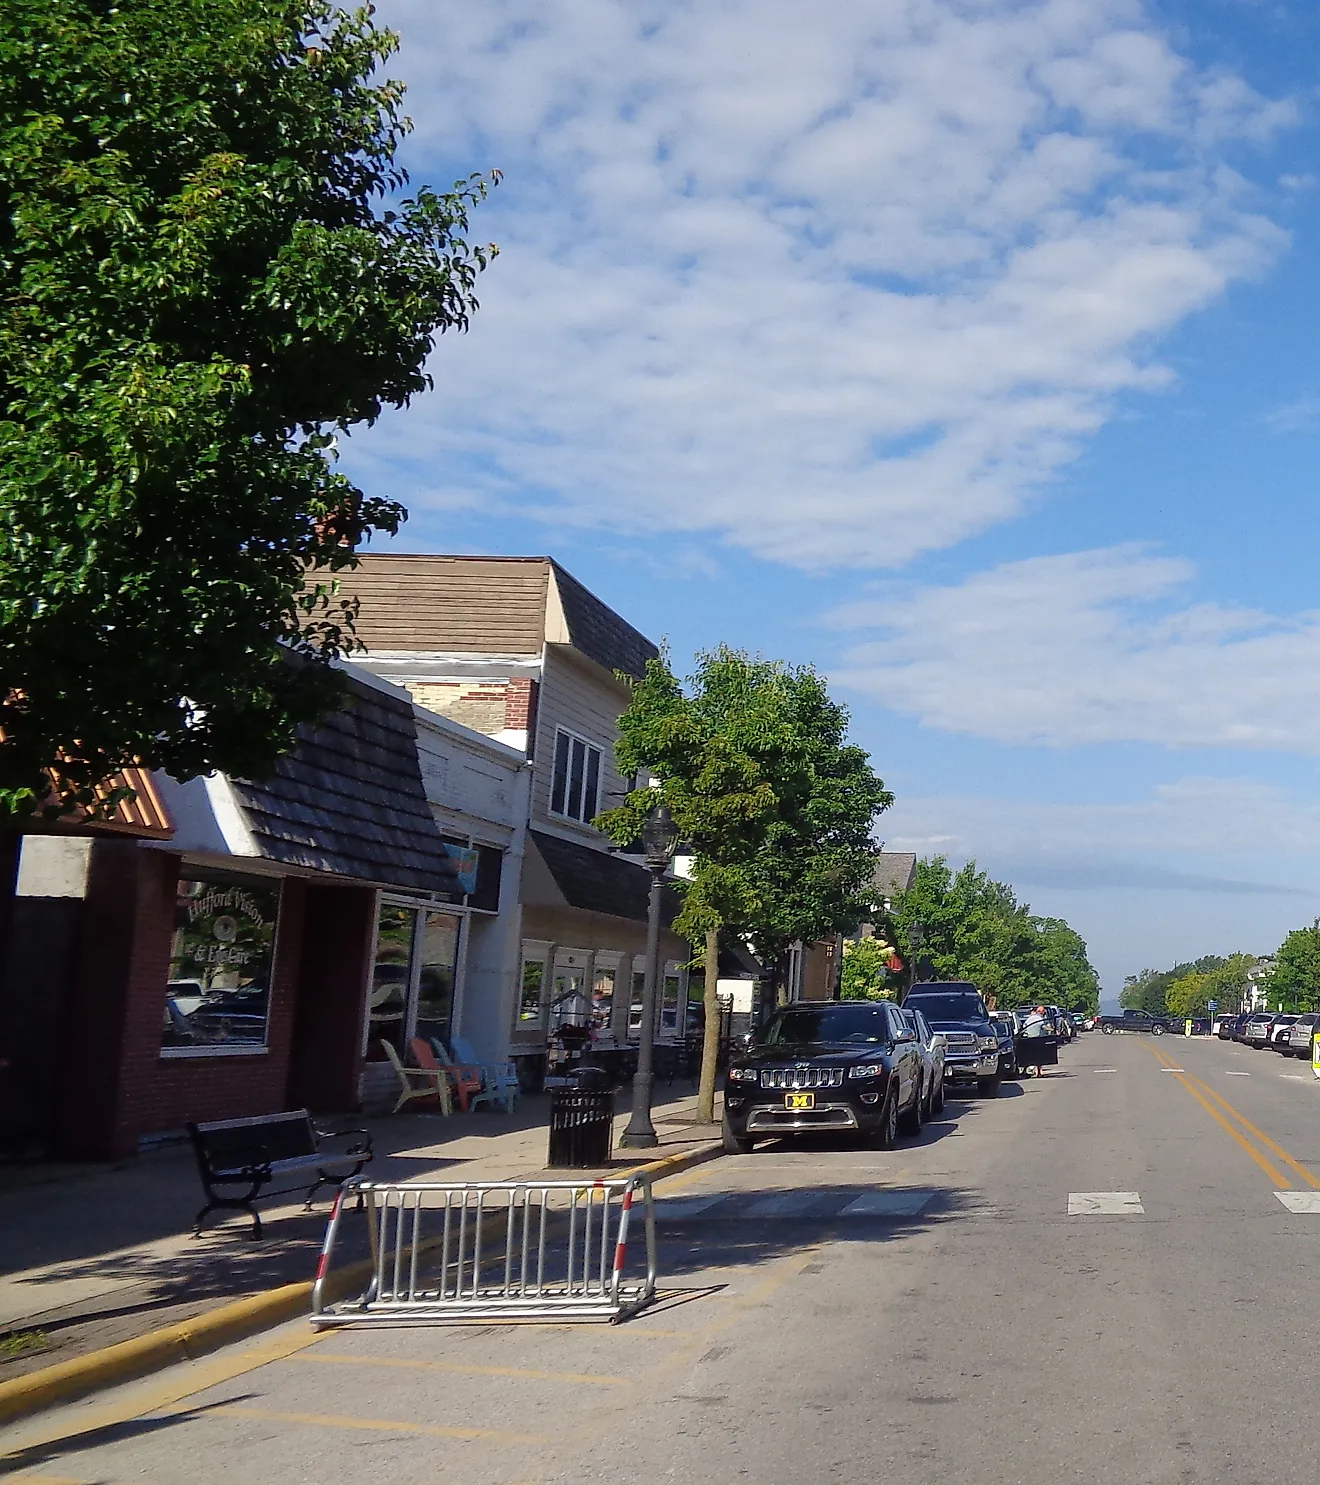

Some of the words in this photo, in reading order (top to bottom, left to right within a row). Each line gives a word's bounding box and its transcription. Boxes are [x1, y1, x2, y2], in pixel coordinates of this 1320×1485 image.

[235, 887, 264, 930] Vision
[194, 944, 206, 962] &
[792, 1096, 808, 1107] M
